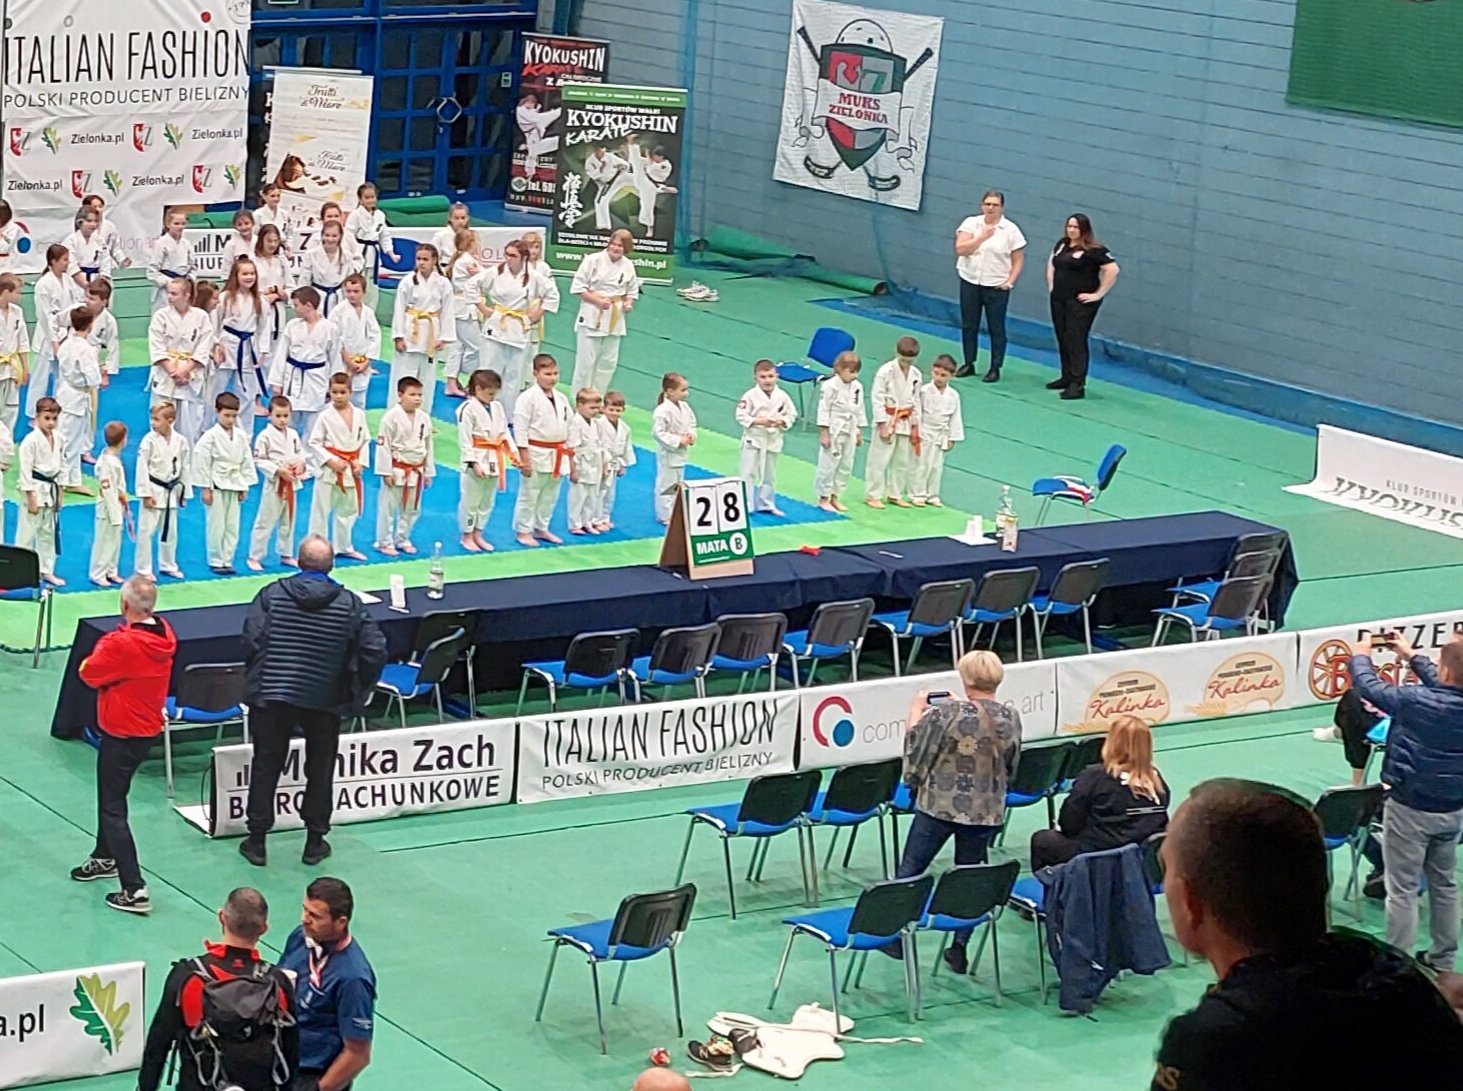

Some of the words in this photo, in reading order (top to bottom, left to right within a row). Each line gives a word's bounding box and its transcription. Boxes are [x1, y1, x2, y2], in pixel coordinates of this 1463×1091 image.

[3, 32, 115, 86] ITALIAN
[127, 28, 252, 82] FASHION
[524, 39, 606, 72] KYOKUSHIN
[3, 92, 63, 108] POLSKI
[69, 87, 174, 106] PRODUCENT
[178, 85, 250, 102] BIELIZNY
[838, 92, 881, 110] MUKS
[566, 108, 678, 134] KYOKUSHIN
[828, 104, 888, 123] ZIELONKA
[71, 131, 125, 146] Zielonka.pl
[191, 127, 244, 141] Zielonka.pl
[7, 179, 63, 192] Zielonka.pl
[131, 173, 185, 187] Zielonka.pl
[695, 496, 713, 527] 2
[722, 491, 741, 523] 8
[695, 538, 730, 555] MATA
[733, 537, 743, 550] B
[1207, 673, 1284, 699] Kalinka
[1089, 696, 1168, 720] Kalinka
[542, 708, 653, 768] ITALIAN
[660, 697, 780, 759] FASHION
[411, 734, 495, 772] Zach
[541, 771, 599, 790] POLSKI
[602, 761, 703, 783] PRODUCENT
[704, 751, 777, 771] BIELIZNY
[337, 775, 501, 811] ACHUNKOWE
